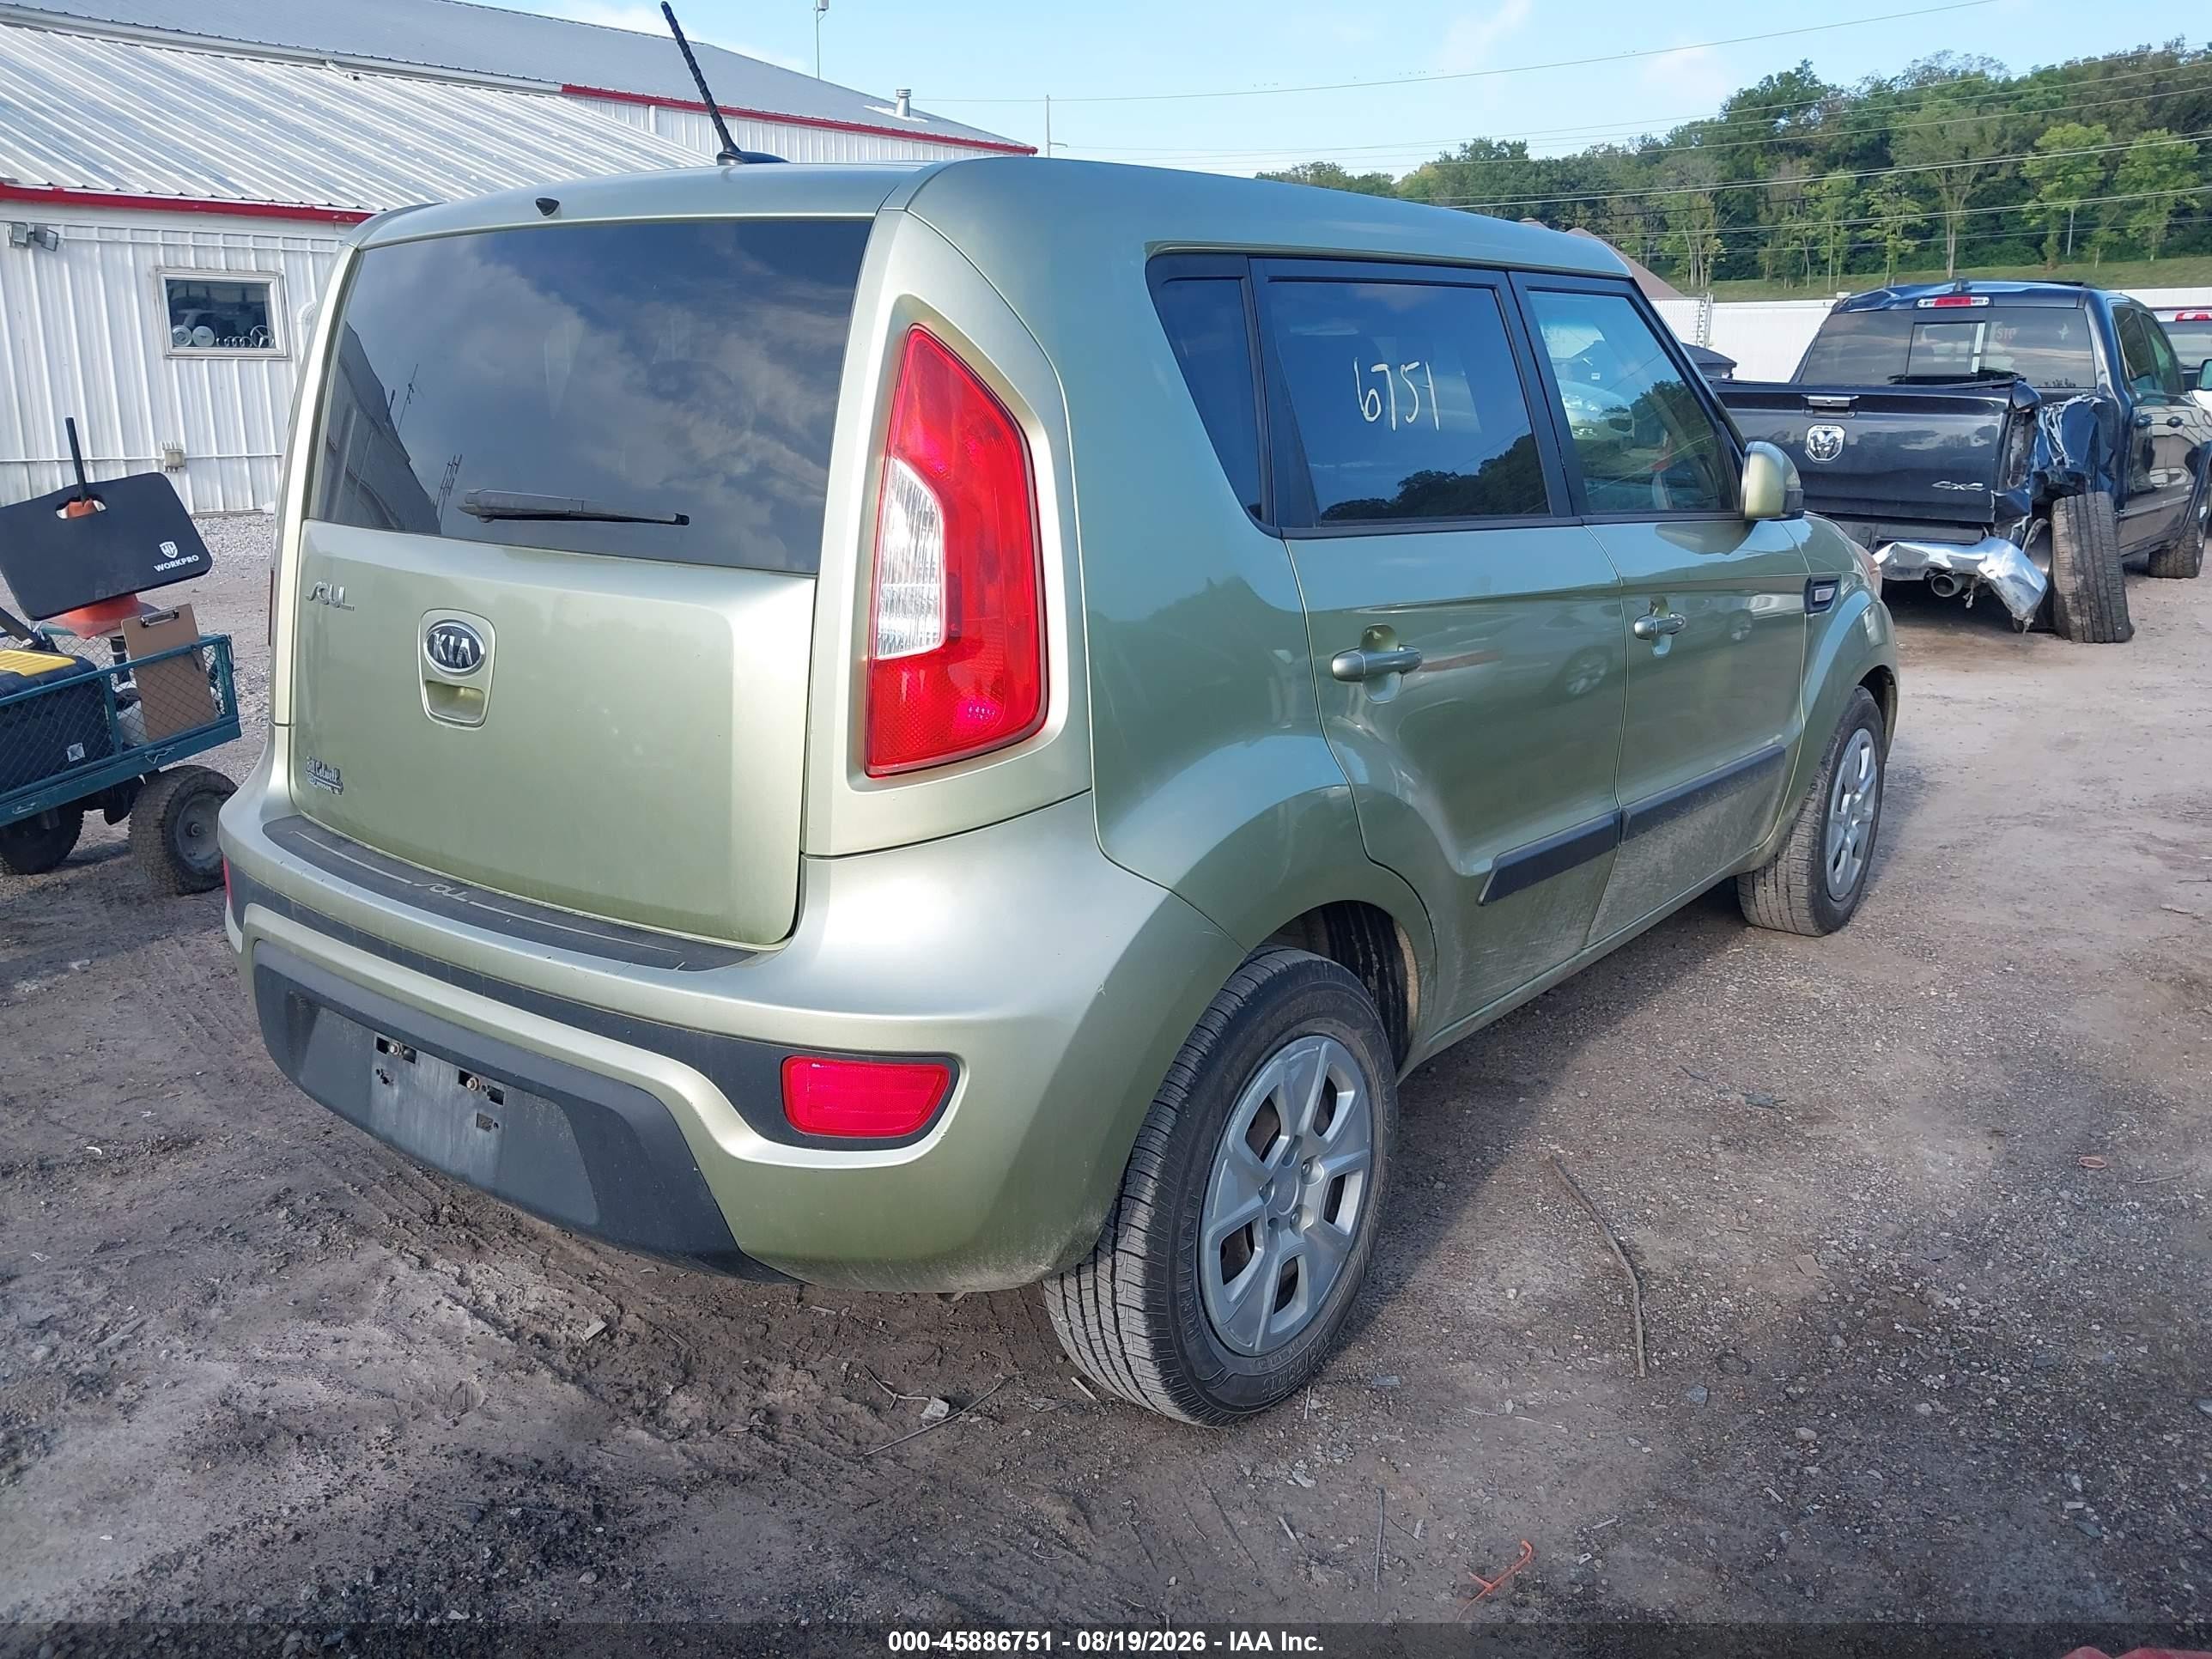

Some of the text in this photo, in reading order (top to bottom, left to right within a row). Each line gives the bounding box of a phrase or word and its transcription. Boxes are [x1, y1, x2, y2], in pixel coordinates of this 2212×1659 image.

[1353, 356, 1441, 432] 6751
[153, 554, 200, 573] WORKPRO
[433, 631, 473, 667] KIA
